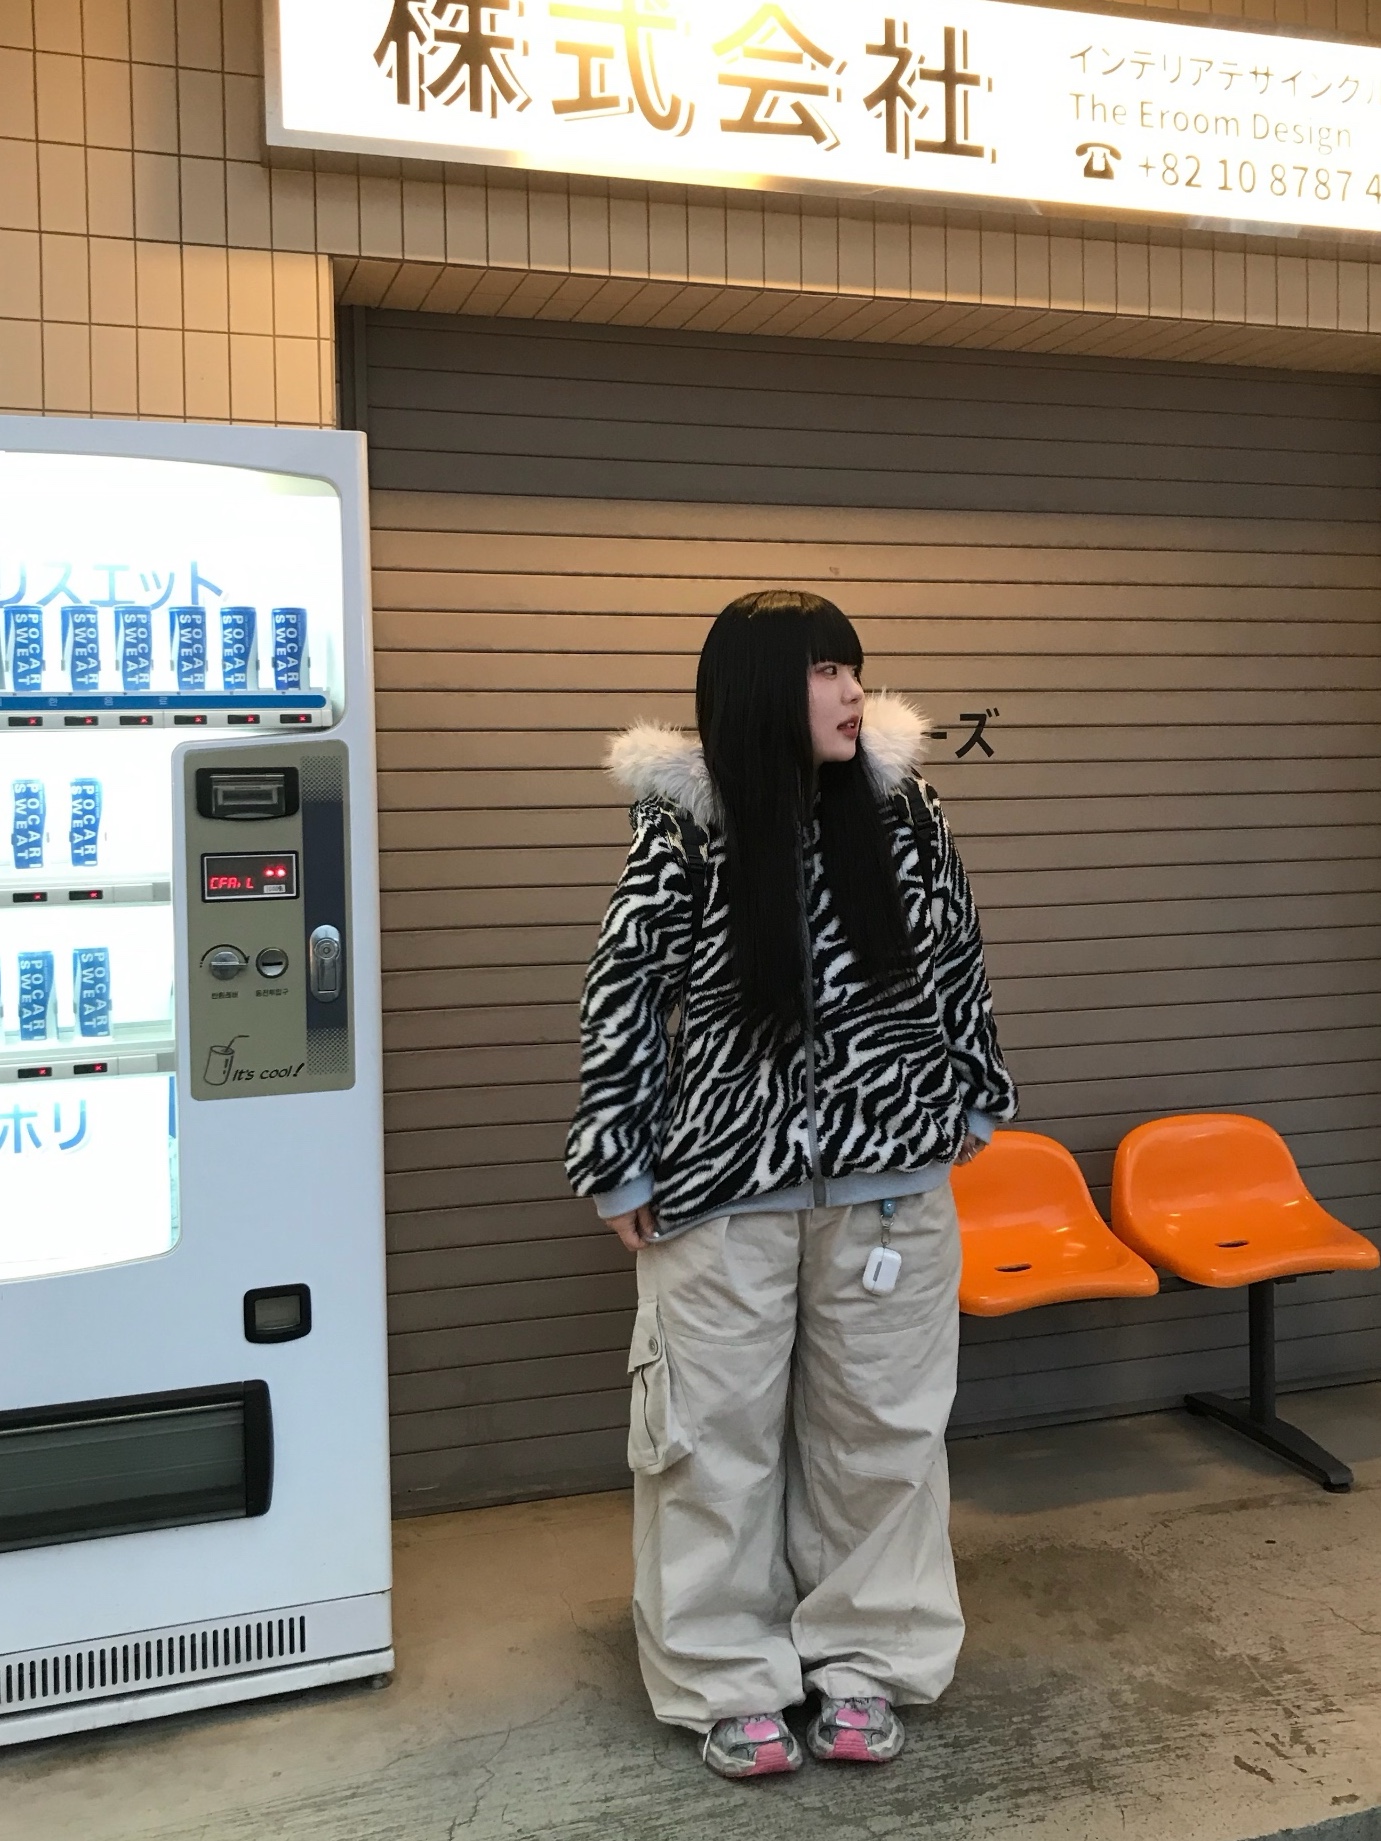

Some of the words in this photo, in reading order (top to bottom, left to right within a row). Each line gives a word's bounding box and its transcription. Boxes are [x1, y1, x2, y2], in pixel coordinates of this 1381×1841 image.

[373, 0, 992, 160] 株式会社
[1069, 92, 1127, 125] The
[1140, 100, 1240, 137] Eroom
[1253, 113, 1351, 156] Design
[1138, 152, 1203, 188] +82
[1218, 158, 1257, 194] 10
[1270, 162, 1353, 201] 8787
[1365, 173, 1381, 205] 4
[15, 613, 30, 686] SWEAT
[74, 613, 89, 685] SWEAT
[124, 613, 139, 685] SWEAT
[180, 614, 194, 685] SWEAT
[222, 615, 235, 684] SWEAT
[275, 614, 288, 684] SWEAT
[14, 783, 29, 860] SWEAT
[26, 783, 42, 868] POCARI
[70, 785, 85, 857] SWEAT
[82, 785, 97, 865] POCARI
[20, 960, 33, 1032] SWEAT
[30, 959, 46, 1040] POCARI
[81, 953, 97, 1028] SWEAT
[94, 952, 108, 1036] POCARI
[259, 1062, 305, 1080] cool!
